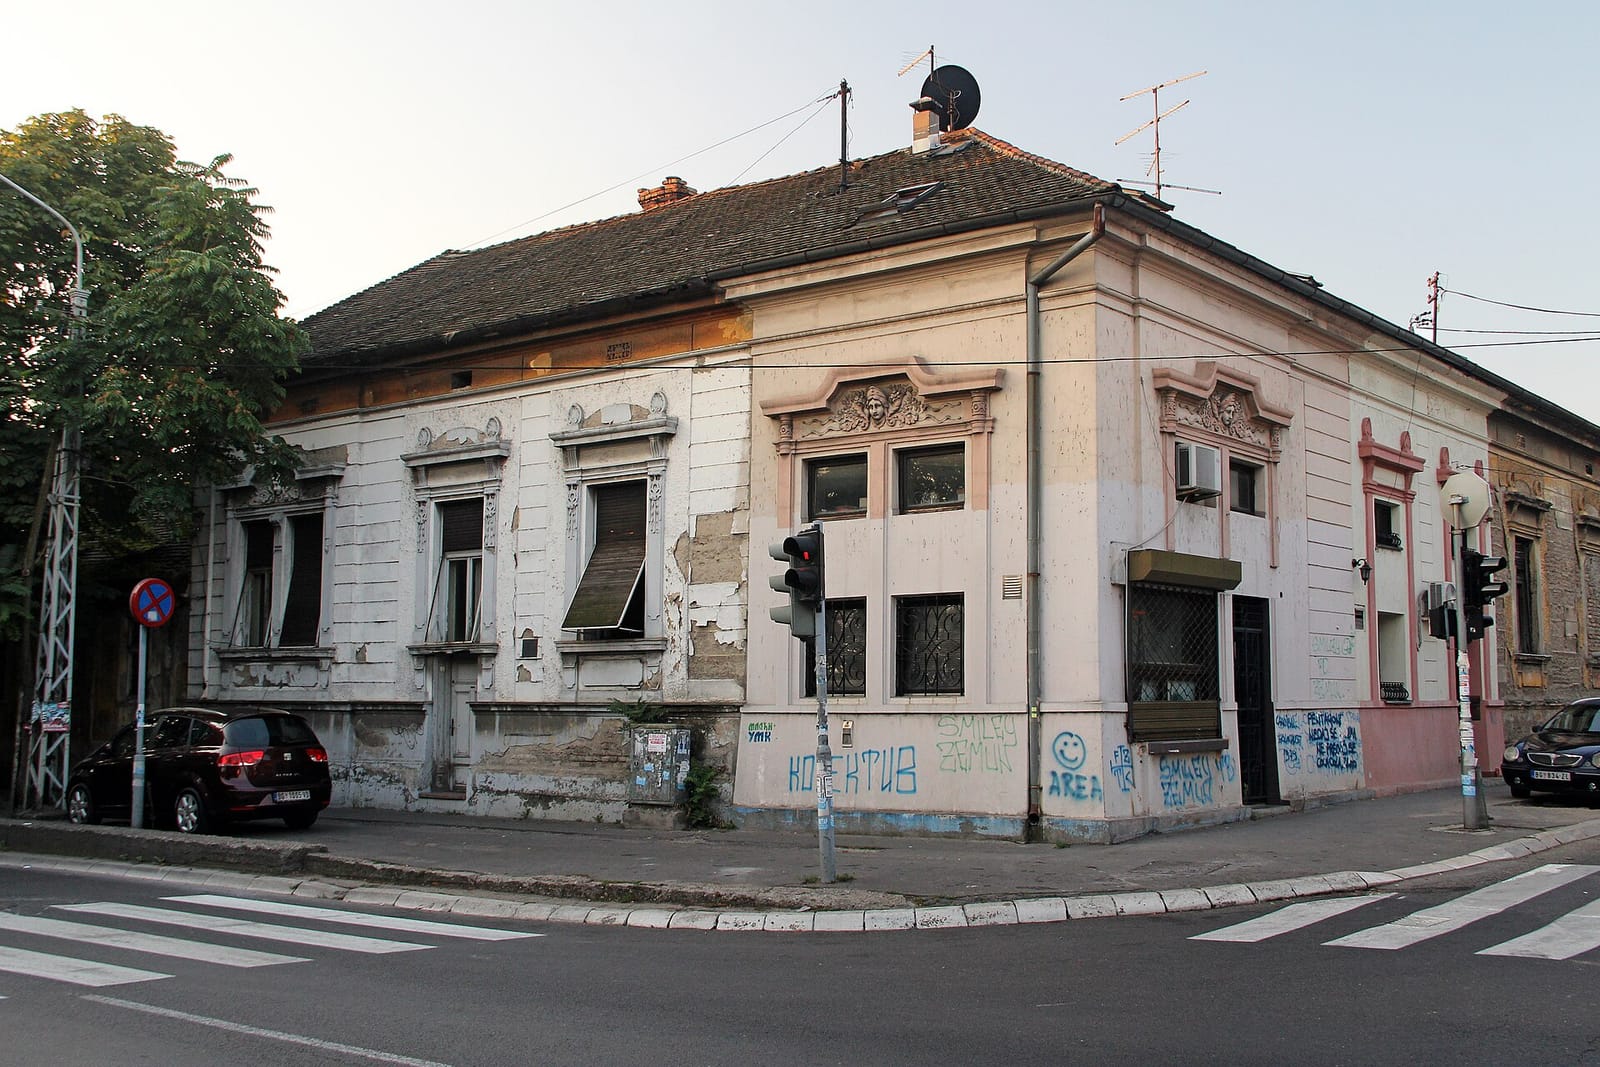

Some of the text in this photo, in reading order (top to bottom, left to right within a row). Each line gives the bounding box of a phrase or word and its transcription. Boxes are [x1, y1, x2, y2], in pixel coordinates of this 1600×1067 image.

[937, 714, 1018, 747] SMILEY
[788, 745, 917, 795] КОЕКТИВ
[936, 738, 1013, 774] ZEMUN
[1049, 770, 1102, 801] AREA
